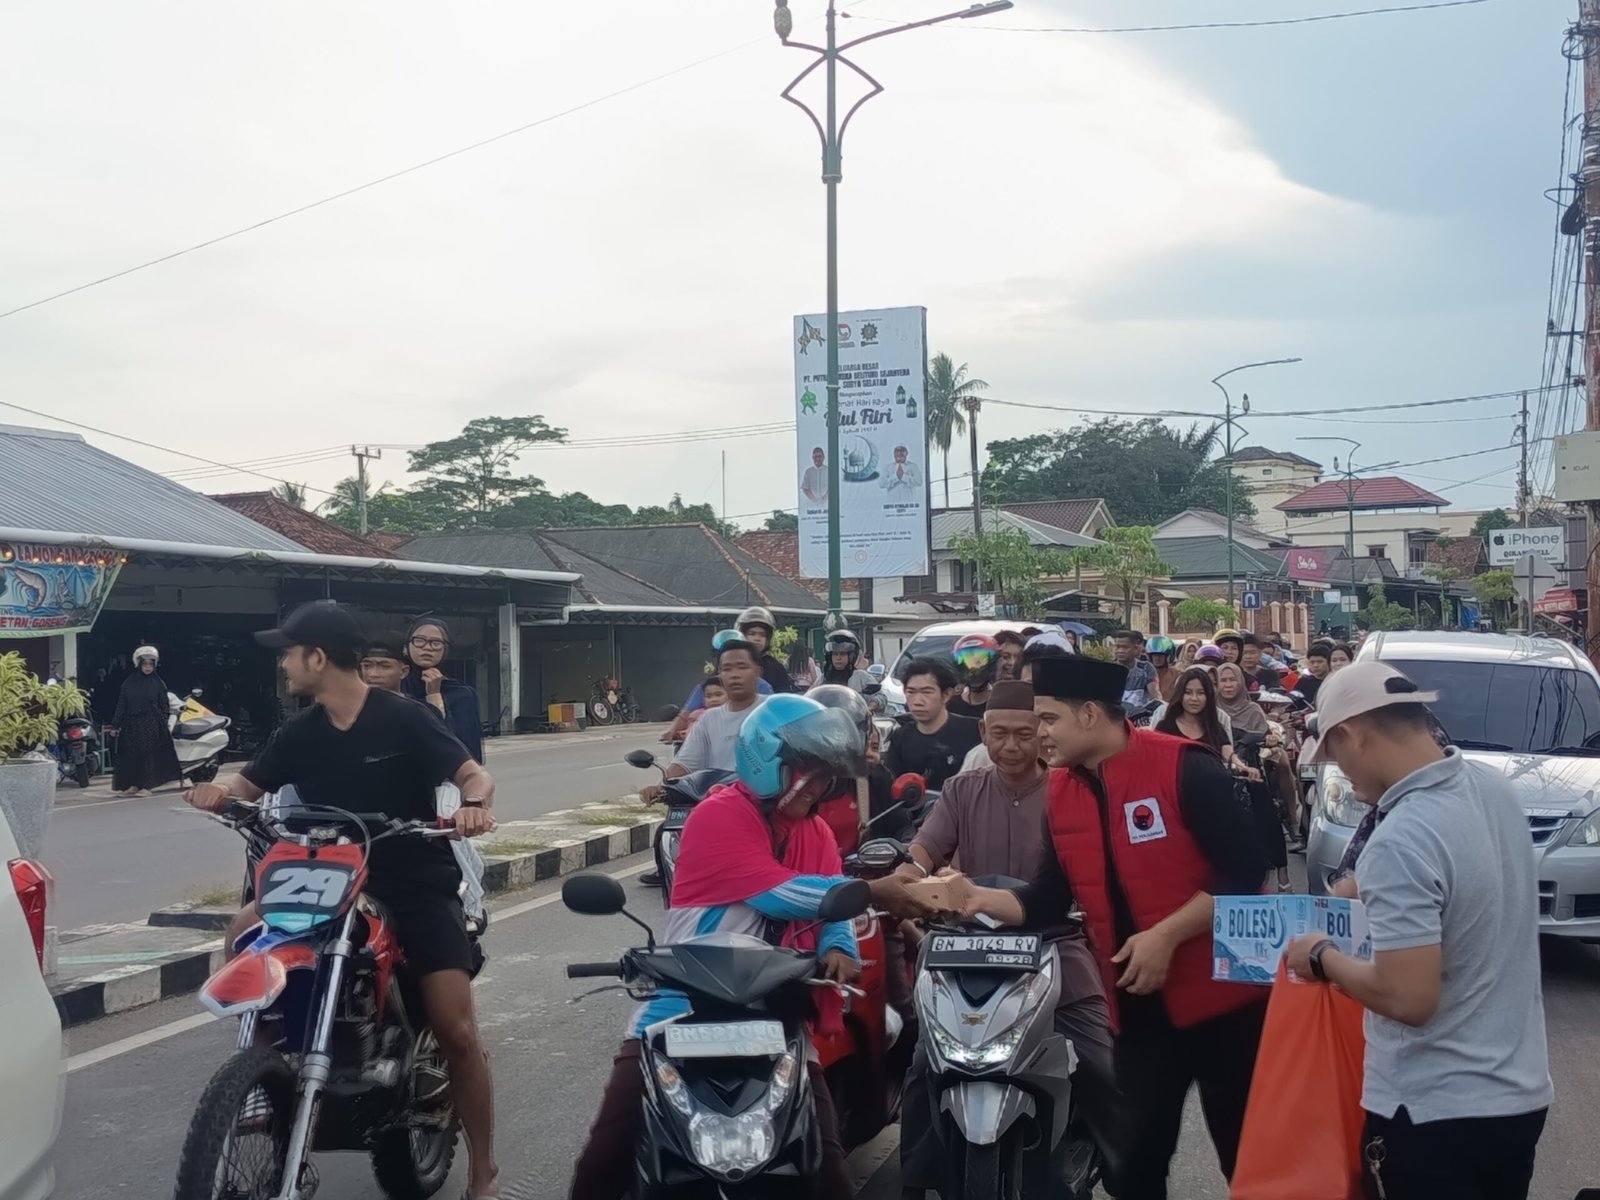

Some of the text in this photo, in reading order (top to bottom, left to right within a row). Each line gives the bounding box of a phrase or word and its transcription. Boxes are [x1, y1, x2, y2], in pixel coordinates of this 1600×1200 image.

[860, 408, 893, 425] Fitri
[1508, 533, 1559, 545] iPhone
[260, 867, 349, 908] 29
[1228, 908, 1277, 939] BOLESA
[935, 939, 1037, 951] BN 3049 RV
